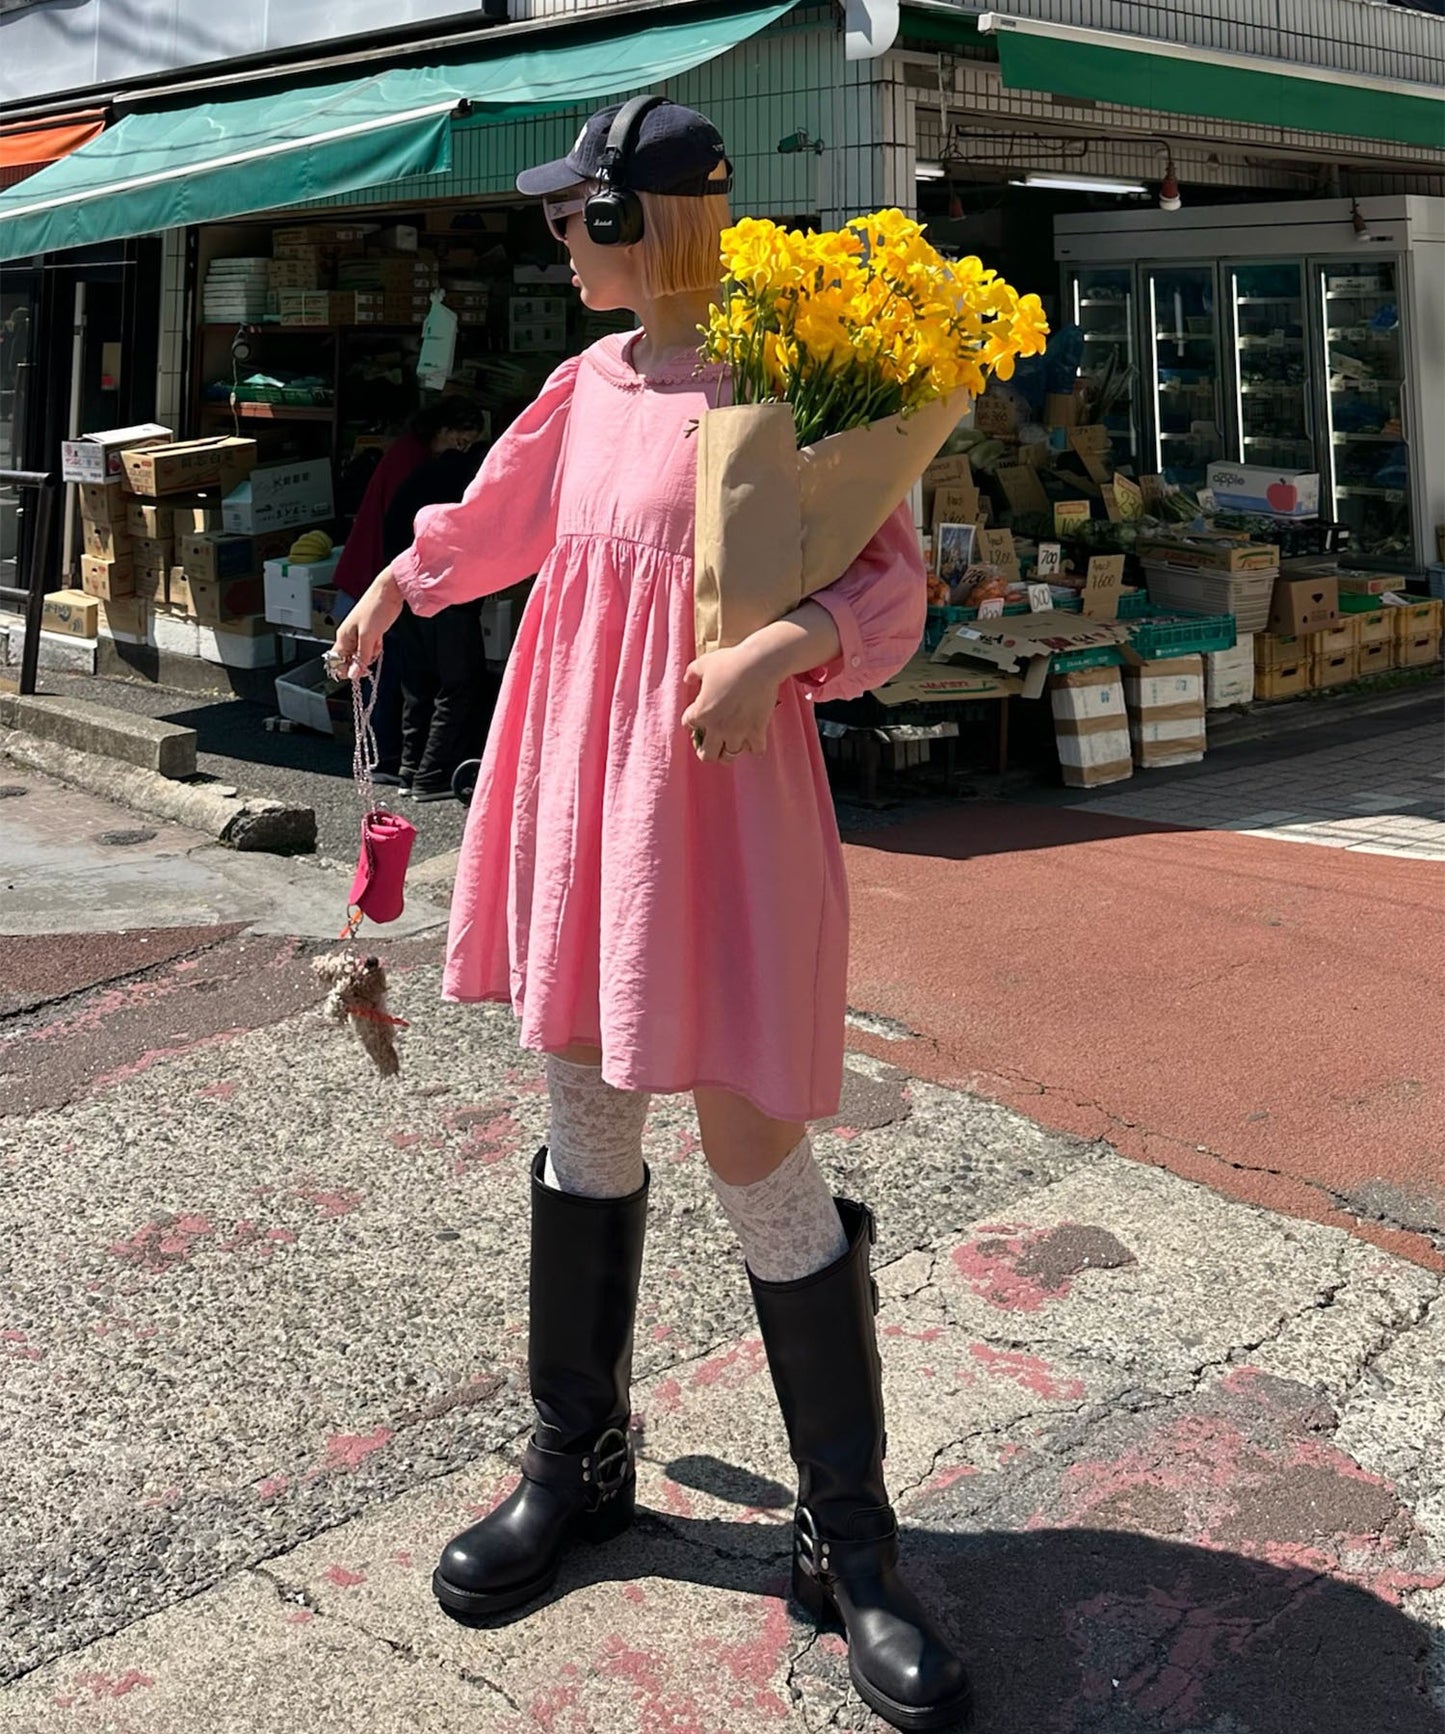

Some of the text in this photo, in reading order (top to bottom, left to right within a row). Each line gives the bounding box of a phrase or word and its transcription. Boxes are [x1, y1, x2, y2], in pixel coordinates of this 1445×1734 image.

[1212, 471, 1246, 488] apple
[1040, 550, 1058, 565] 700
[1032, 587, 1050, 611] 600
